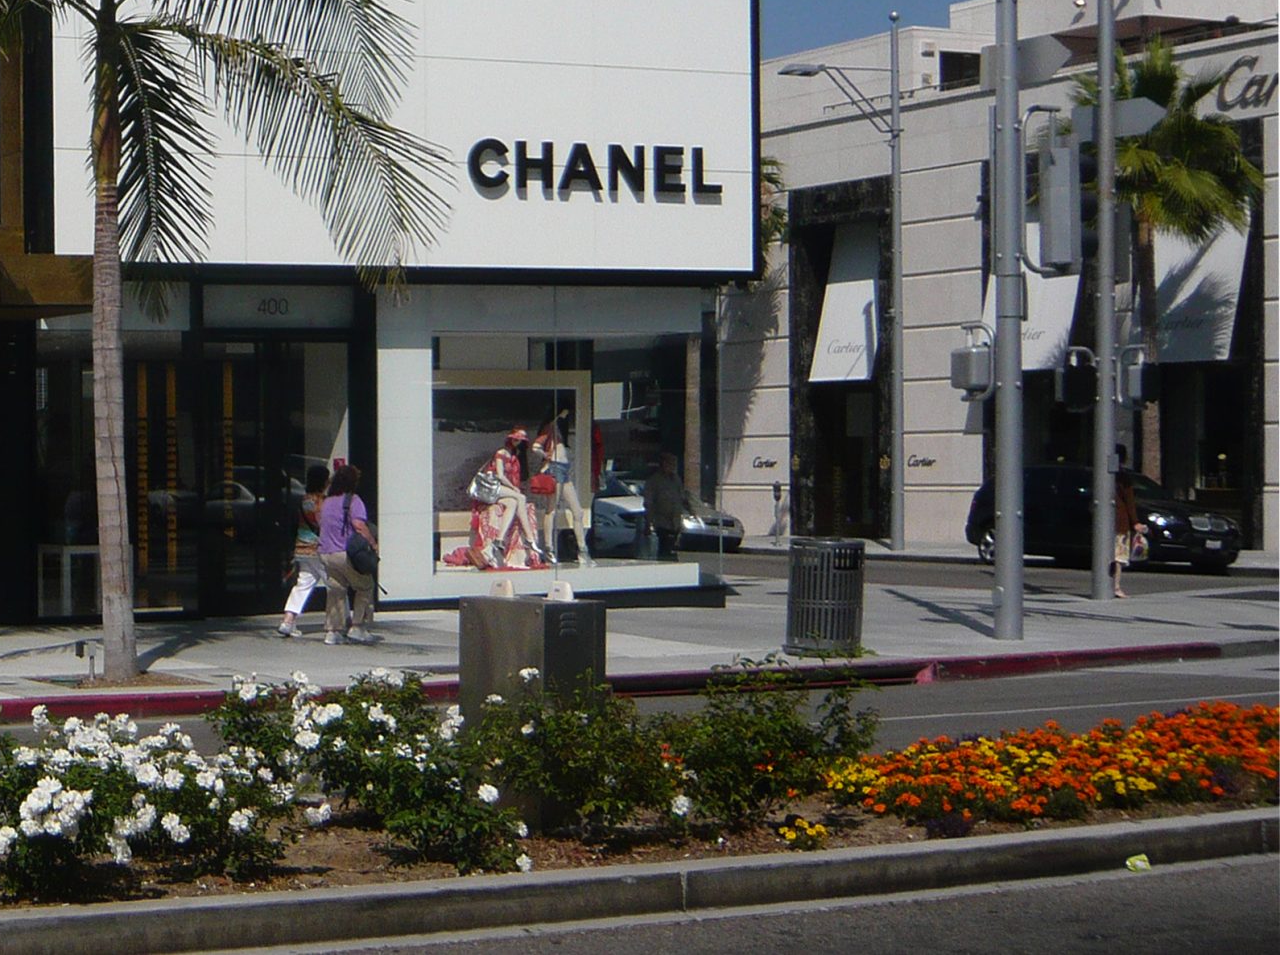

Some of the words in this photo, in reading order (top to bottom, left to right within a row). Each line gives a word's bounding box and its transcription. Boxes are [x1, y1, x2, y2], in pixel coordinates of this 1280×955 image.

[468, 138, 723, 194] CHANEL
[257, 298, 289, 316] 400
[827, 339, 864, 354] Cartier
[907, 454, 937, 467] Cartier
